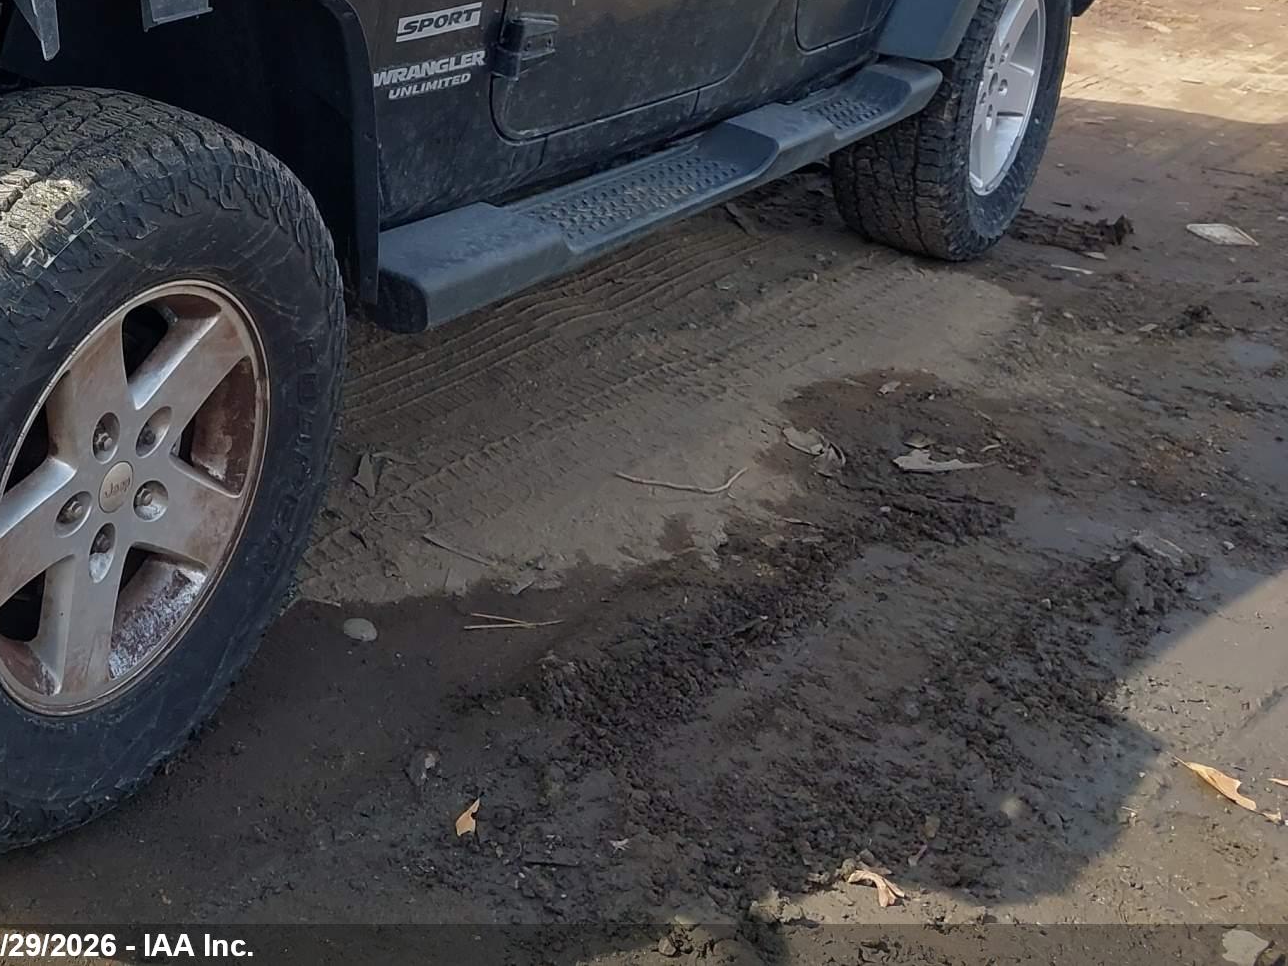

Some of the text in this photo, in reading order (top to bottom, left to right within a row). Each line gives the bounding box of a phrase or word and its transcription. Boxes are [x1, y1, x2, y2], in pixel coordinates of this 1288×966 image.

[398, 7, 481, 37] SPORT
[372, 50, 487, 88] WRANGLER
[388, 72, 472, 100] UNLIMITED
